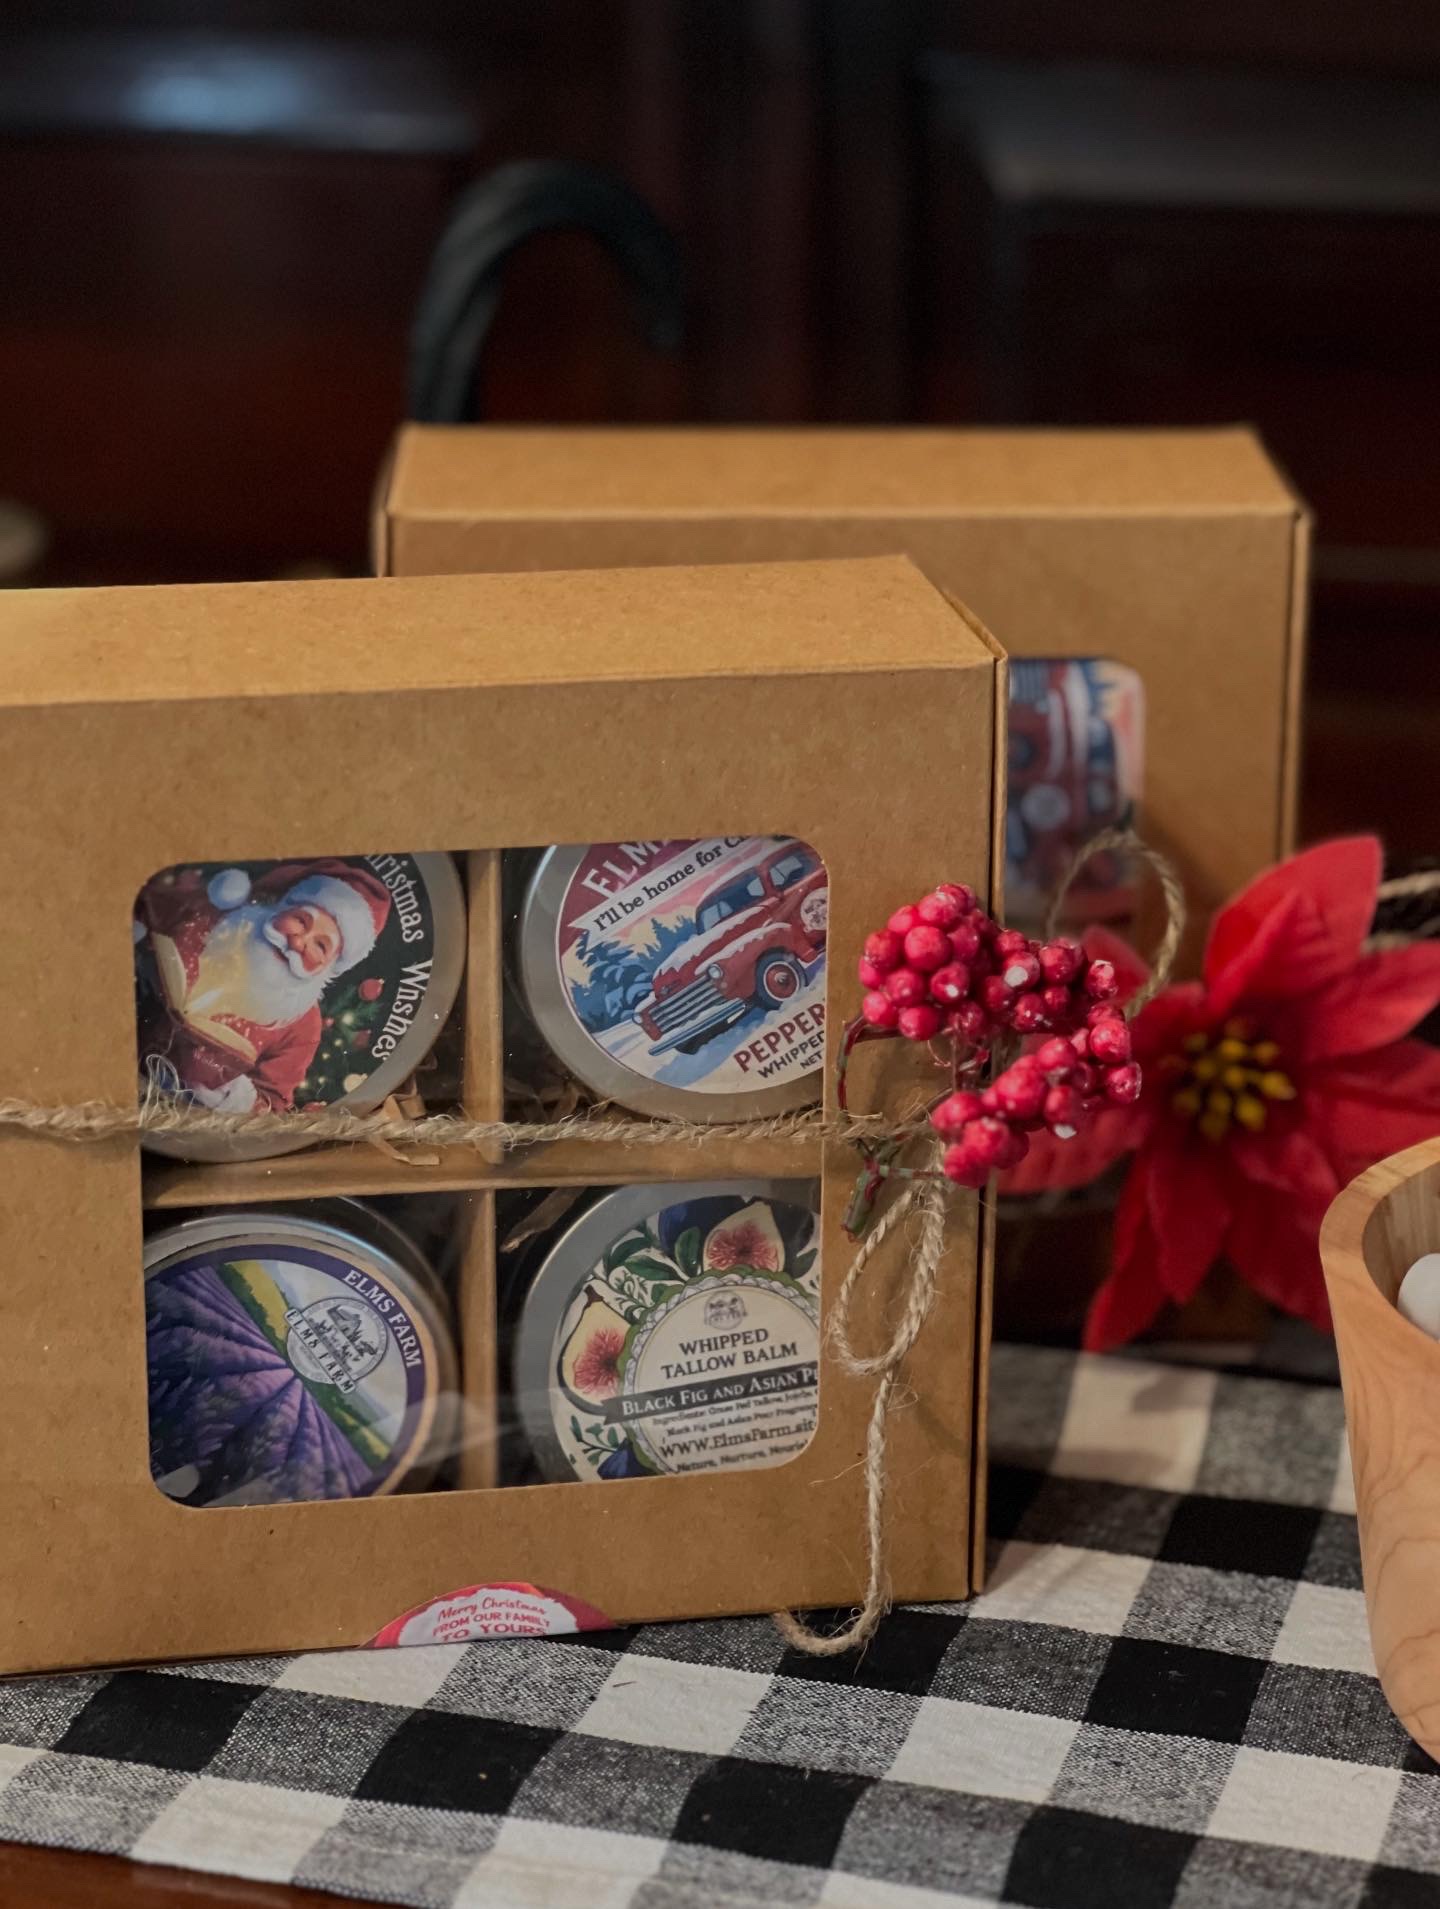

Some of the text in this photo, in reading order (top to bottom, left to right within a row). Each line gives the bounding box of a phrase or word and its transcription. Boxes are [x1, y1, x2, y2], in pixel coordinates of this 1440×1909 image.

[581, 840, 671, 899] ELM
[594, 836, 751, 932] I'll be home for C
[800, 1051, 823, 1069] NET
[286, 1311, 320, 1349] ELMS
[343, 1269, 422, 1368] ELMS FARM
[679, 1328, 769, 1355] WHIPPED
[660, 1342, 798, 1380] TALLOW BALM
[660, 1419, 817, 1458] WWW.ElmsFarm.sit
[433, 1612, 550, 1637] FROM OUR FAMILY
[438, 1597, 546, 1622] Merry Christmas
[442, 1623, 546, 1641] TO YOURS
